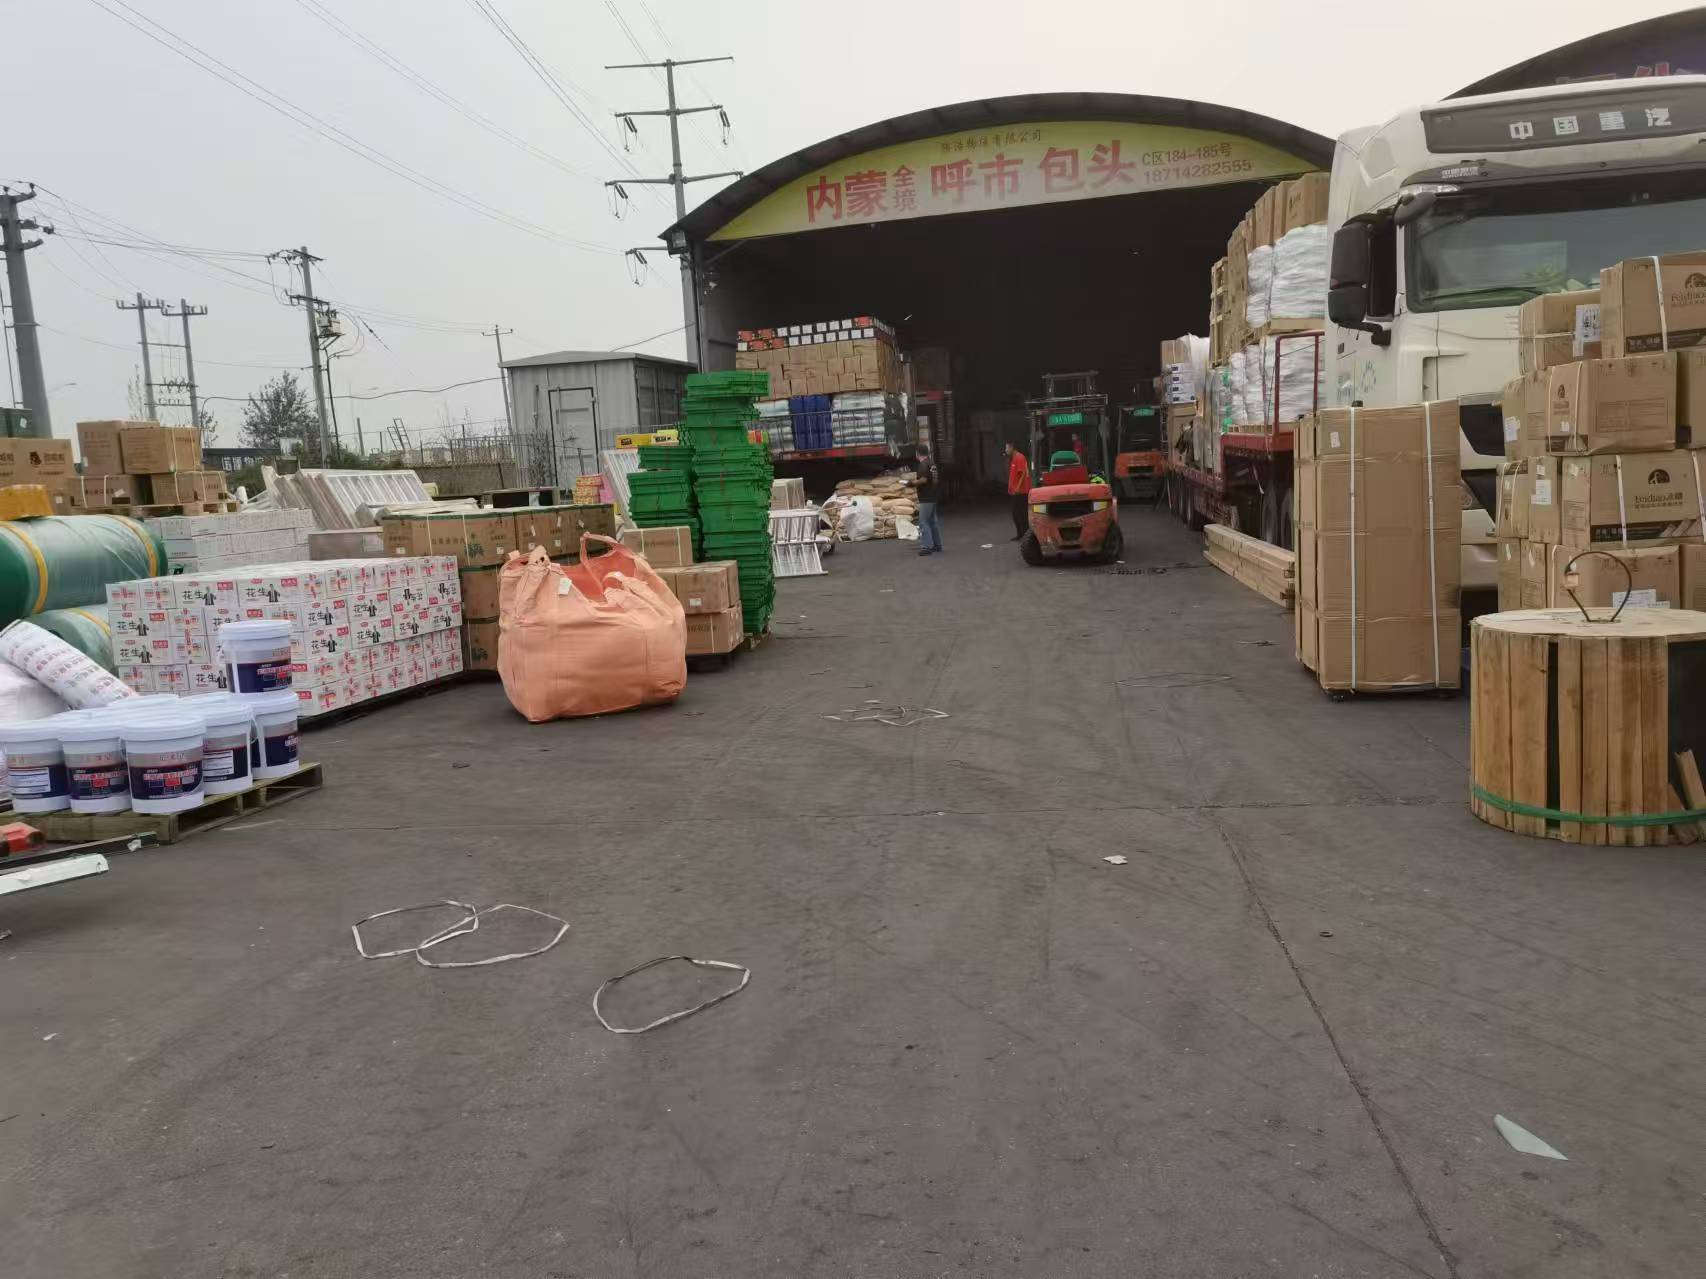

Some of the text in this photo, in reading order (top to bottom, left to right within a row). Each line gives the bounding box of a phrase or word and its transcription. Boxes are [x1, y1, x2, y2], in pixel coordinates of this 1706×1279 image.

[1509, 107, 1673, 140] 中国重汽
[806, 170, 888, 223] 内蒙
[930, 152, 1025, 205] 呼市
[1038, 140, 1136, 194] 包头
